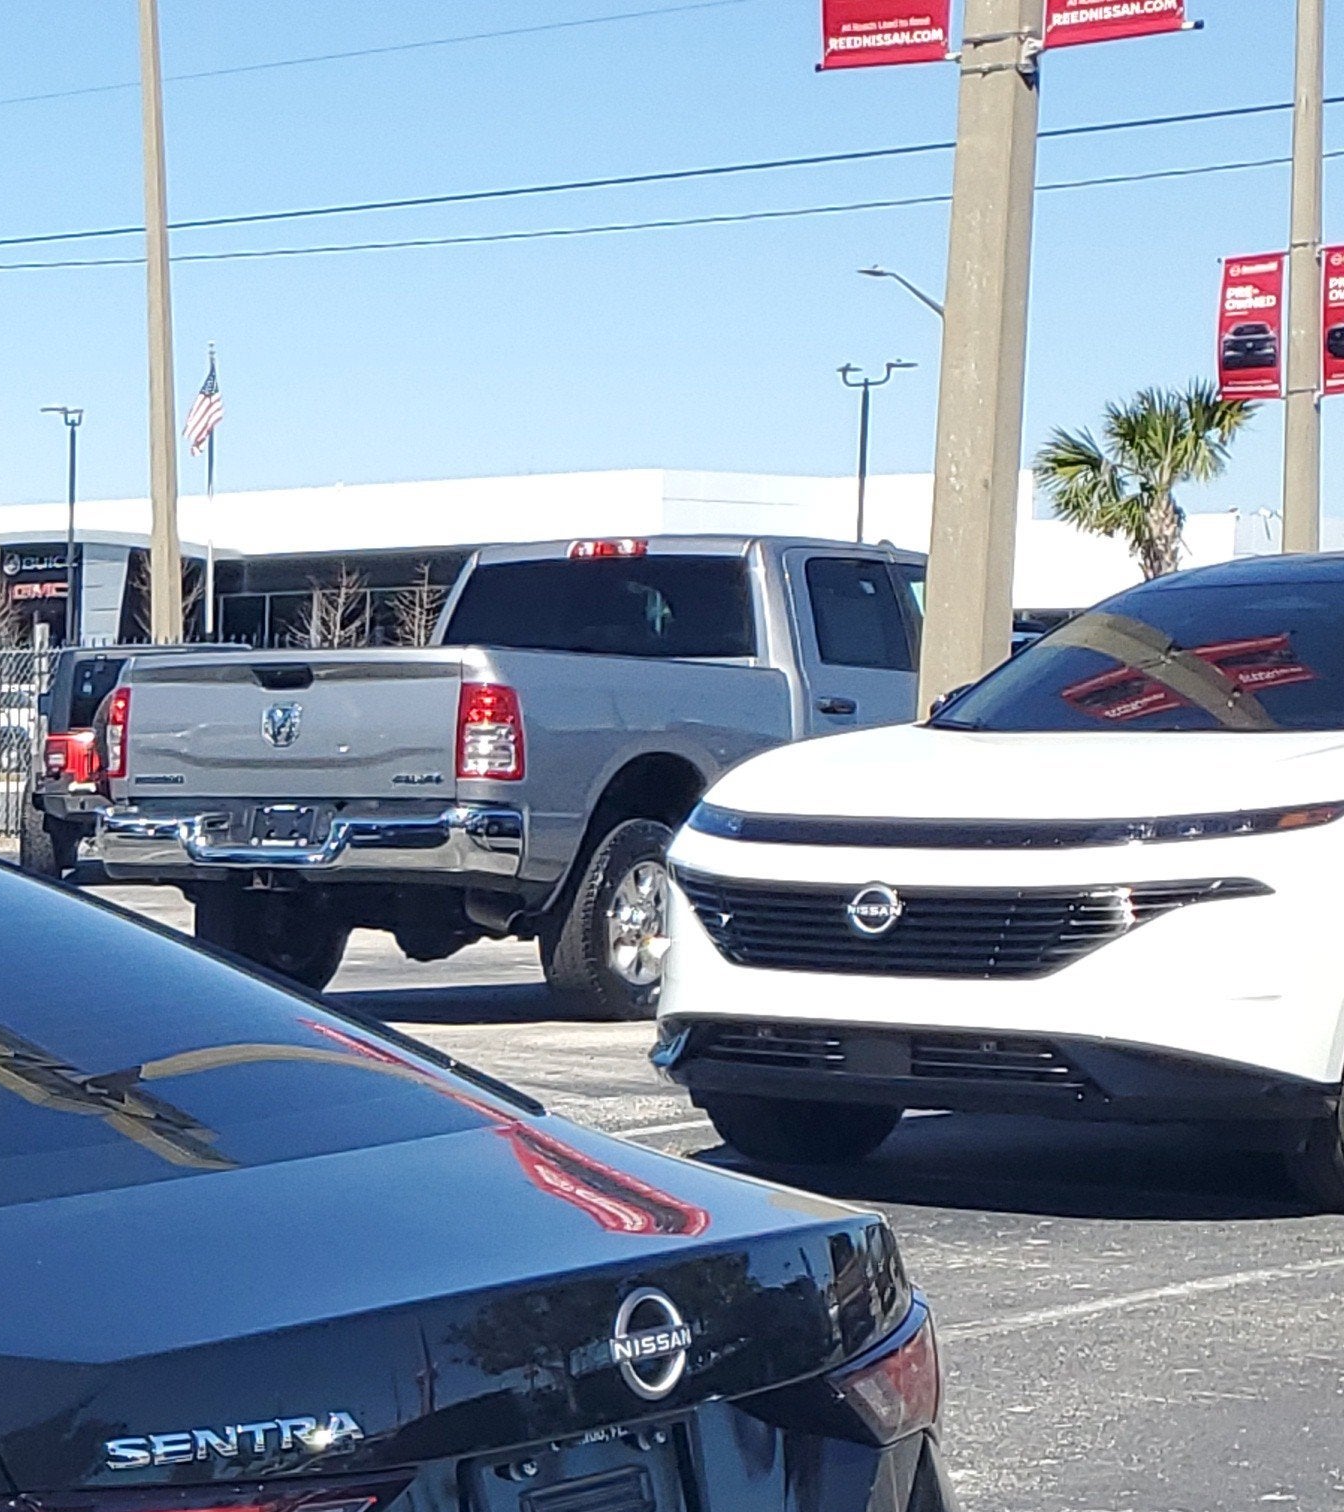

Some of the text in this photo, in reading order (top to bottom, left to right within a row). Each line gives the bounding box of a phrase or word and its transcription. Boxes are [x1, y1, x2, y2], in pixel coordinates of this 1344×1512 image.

[1051, 0, 1178, 26] REEDNISSAN.COM
[828, 27, 944, 50] REEDNISSAN.COM
[1224, 295, 1277, 310] OWNED
[847, 904, 903, 917] NISSAN
[614, 1328, 692, 1360] NISSAN
[105, 1412, 365, 1471] SENTRA
